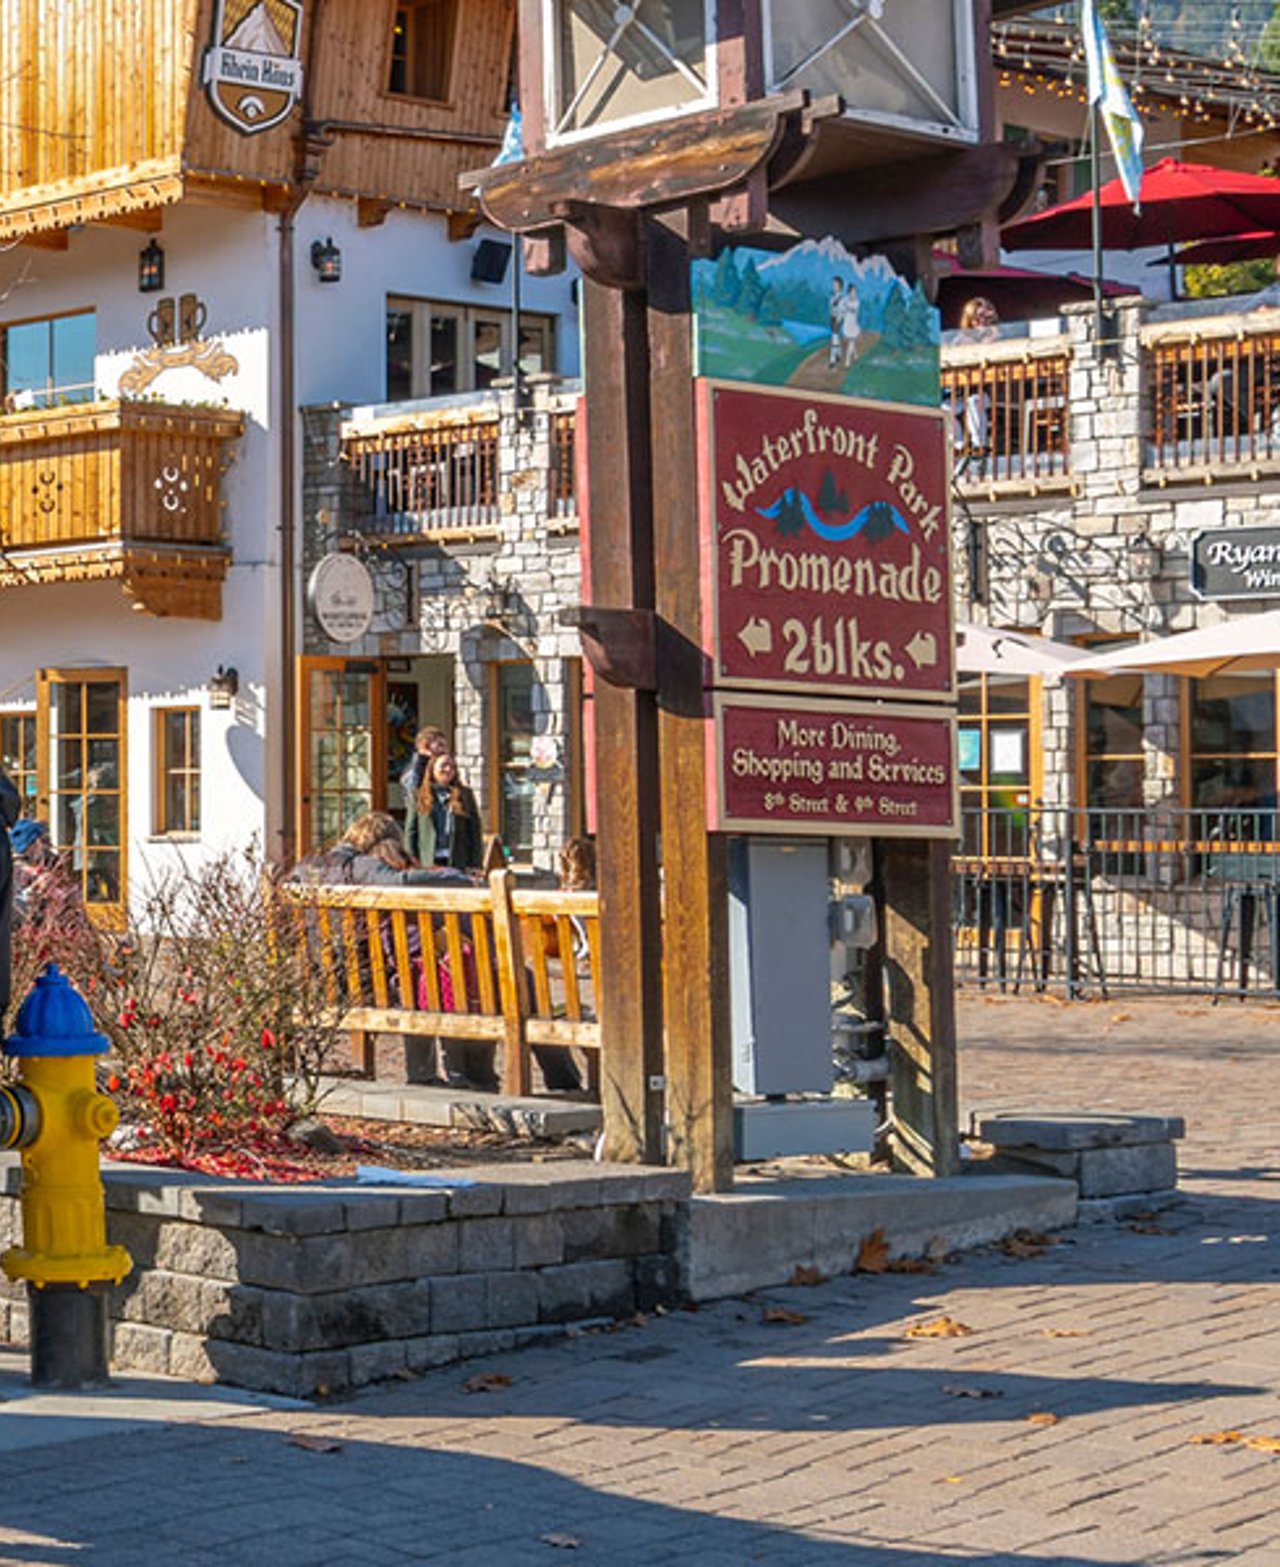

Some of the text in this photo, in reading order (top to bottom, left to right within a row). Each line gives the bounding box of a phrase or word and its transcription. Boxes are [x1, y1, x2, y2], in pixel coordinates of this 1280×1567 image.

[722, 409, 943, 540] Waterfront Park
[721, 528, 942, 603] Promenade
[777, 719, 902, 757] More Dining,
[732, 748, 946, 784] Shopping and Services
[789, 793, 828, 813] Street
[835, 793, 850, 814] &
[879, 796, 918, 816] Street
